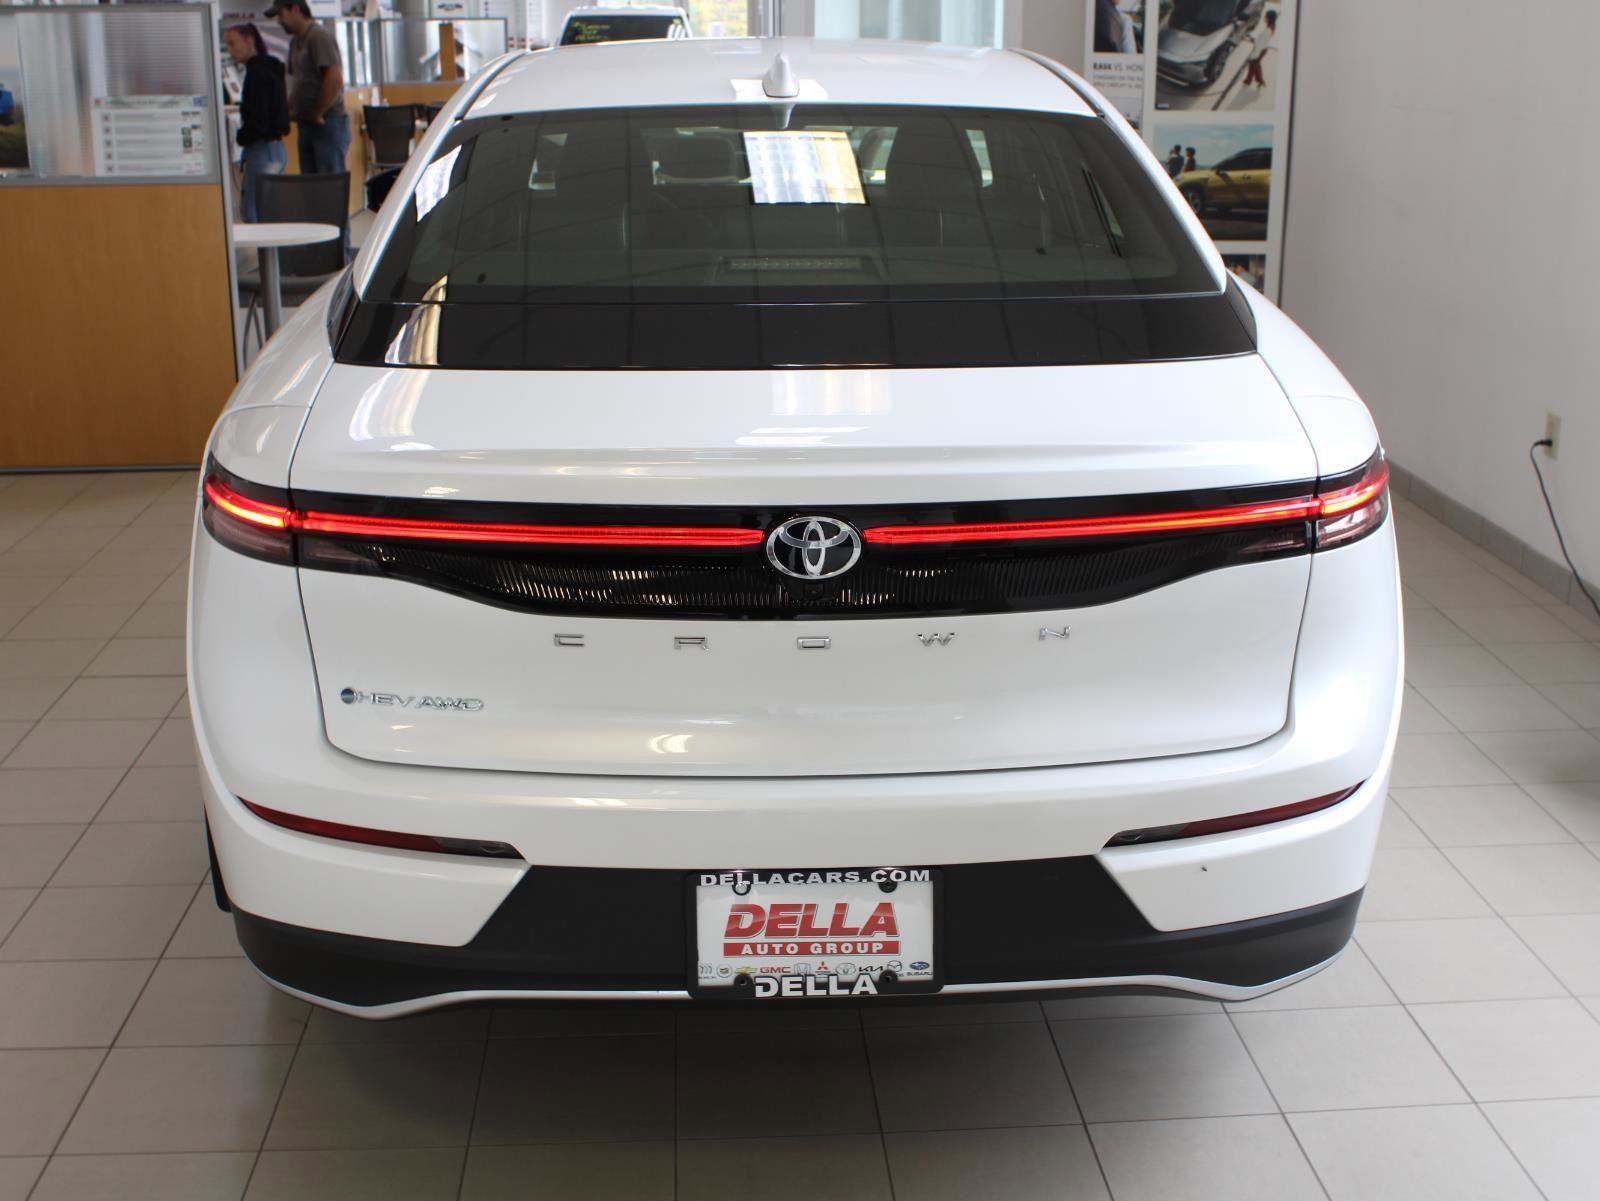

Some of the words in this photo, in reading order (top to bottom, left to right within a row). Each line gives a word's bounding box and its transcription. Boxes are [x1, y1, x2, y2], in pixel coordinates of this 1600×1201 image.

[415, 696, 485, 712] AWD
[700, 870, 930, 886] DELLACARS.COM
[724, 902, 900, 939] DELLA
[741, 943, 799, 955] AUTO
[810, 942, 884, 954] GROUP
[760, 966, 791, 974] GMC
[755, 974, 878, 997] DELLA
